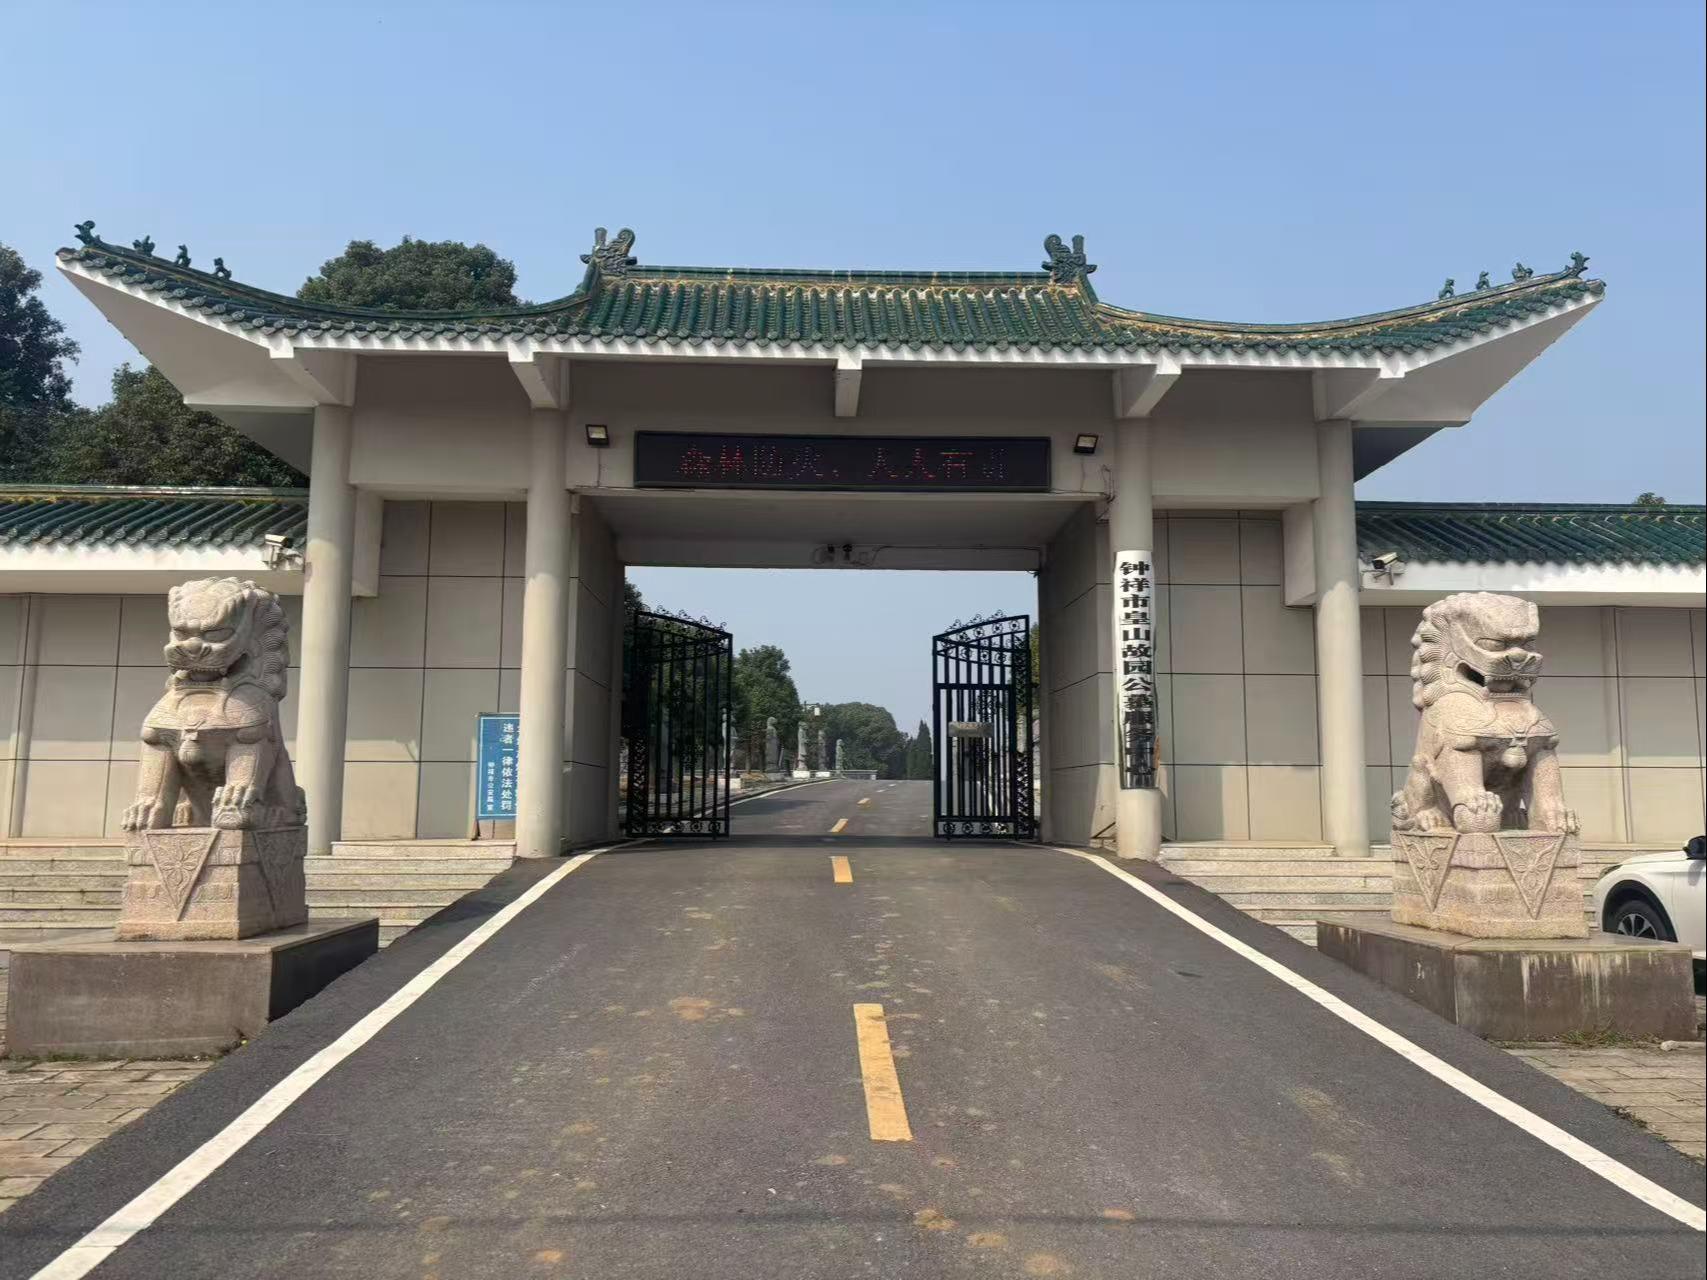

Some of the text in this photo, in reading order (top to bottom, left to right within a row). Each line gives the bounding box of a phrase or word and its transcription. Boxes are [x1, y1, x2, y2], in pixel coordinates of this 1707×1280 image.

[501, 723, 514, 811] 违者一律依法处罚
